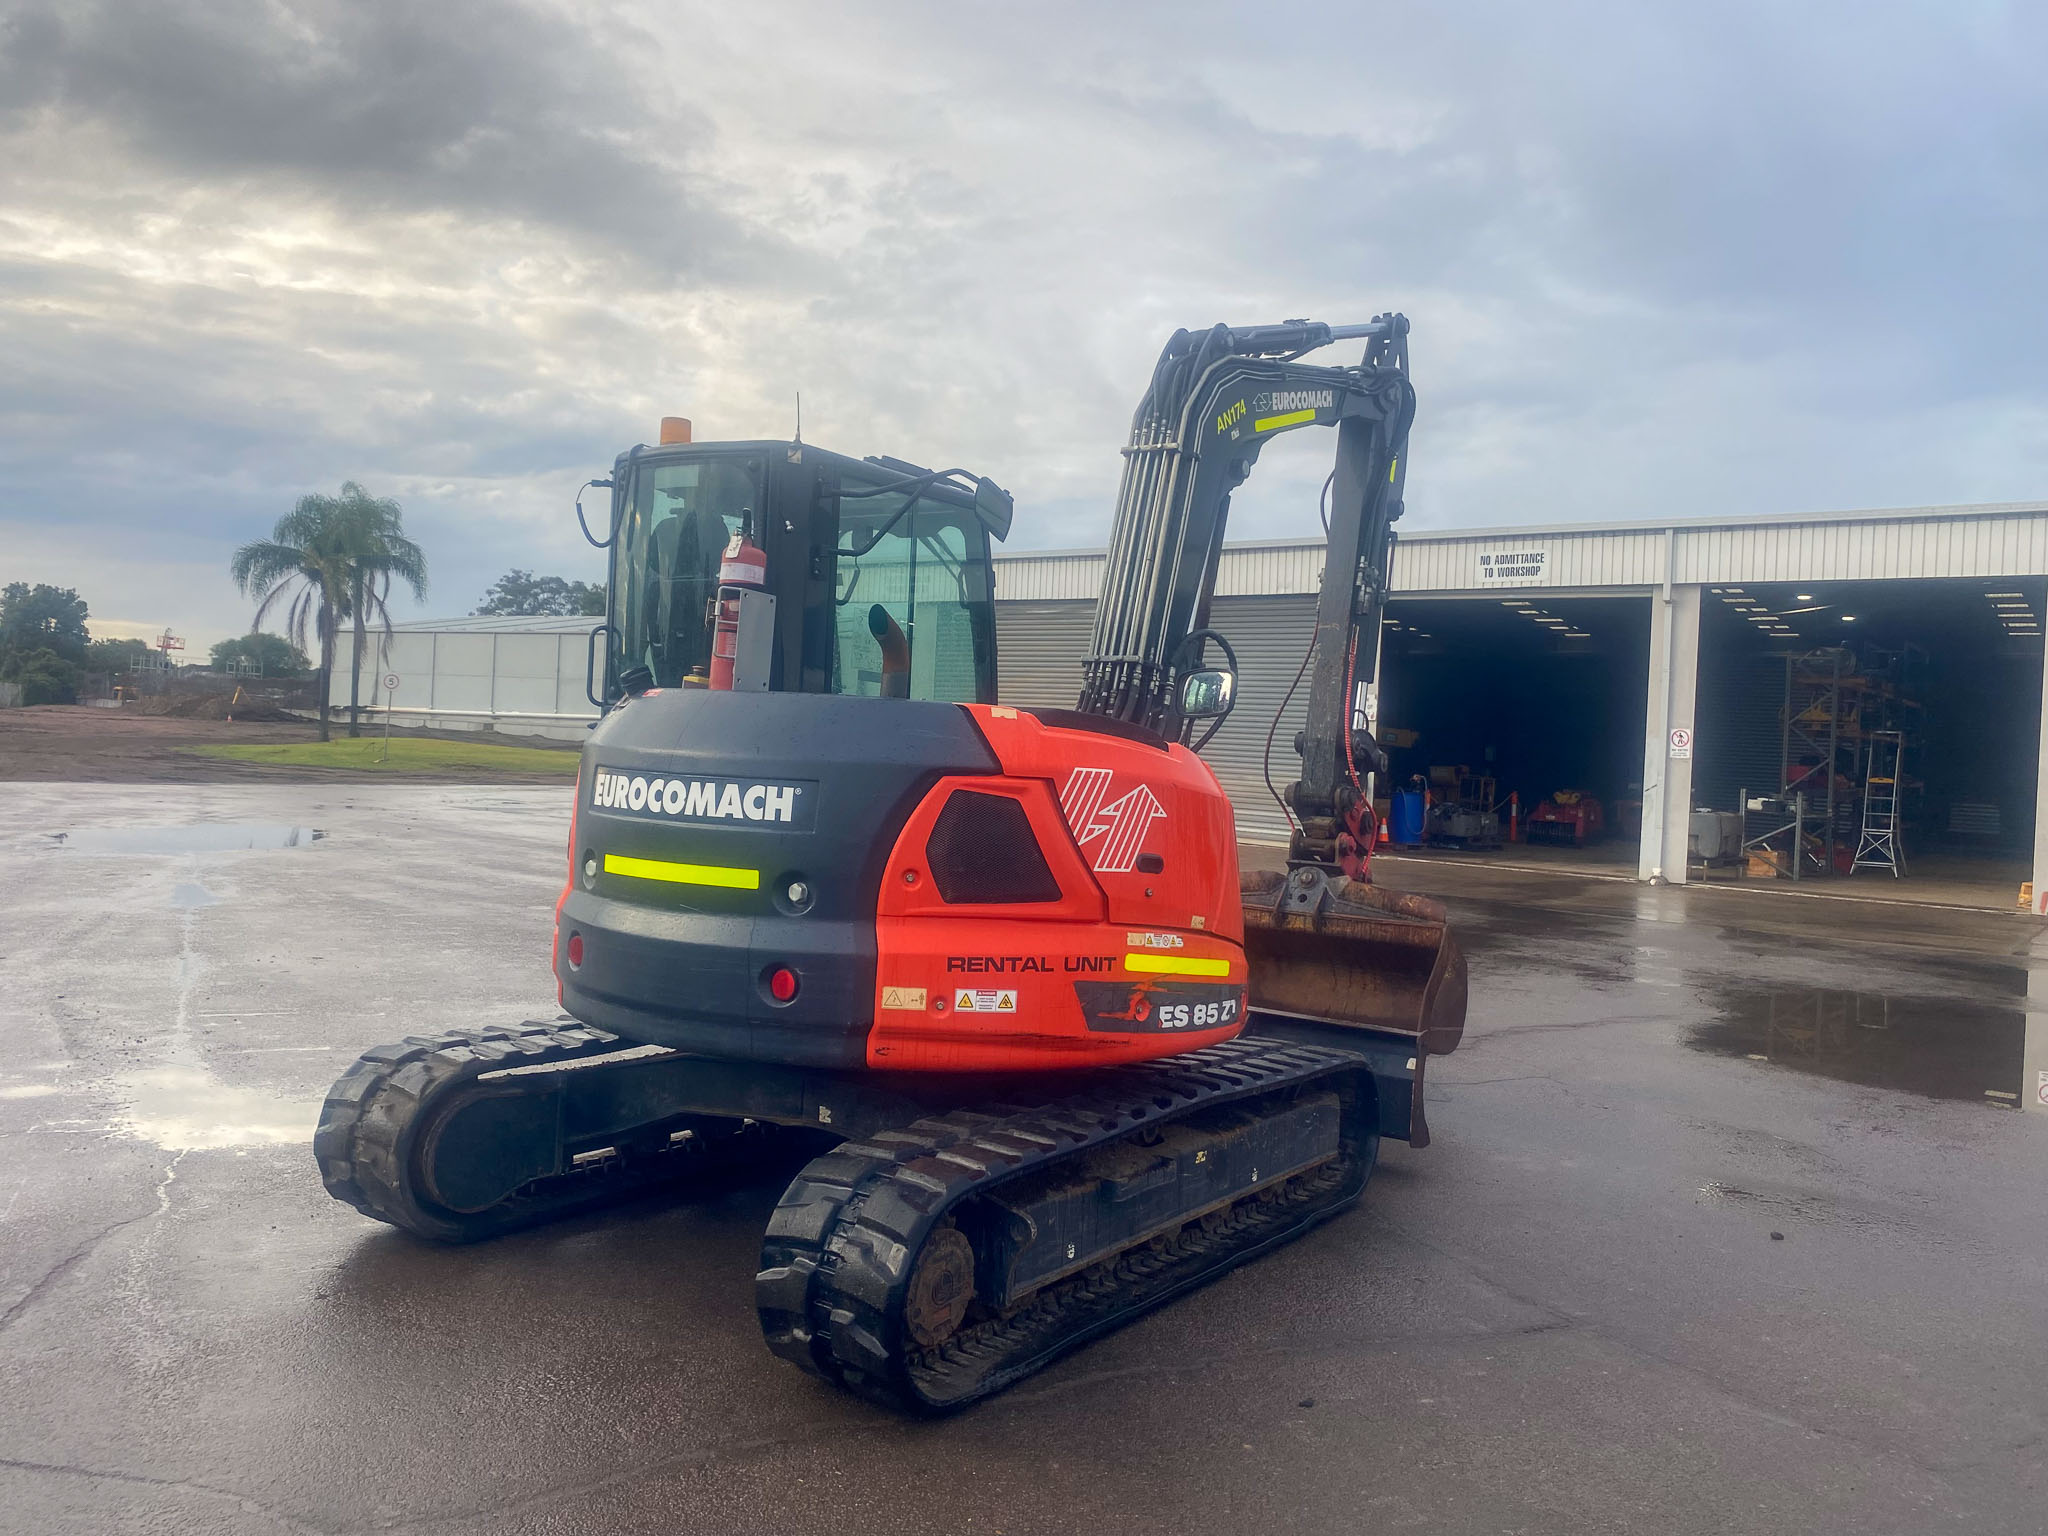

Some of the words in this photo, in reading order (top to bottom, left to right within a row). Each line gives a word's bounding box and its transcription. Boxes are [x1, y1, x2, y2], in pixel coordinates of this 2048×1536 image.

[1272, 390, 1333, 410] EUROCOMACH
[1217, 398, 1246, 435] AN174
[1480, 556, 1491, 565] NO
[1495, 553, 1545, 565] ADMITTANCE
[1484, 567, 1493, 578] TO
[1497, 566, 1541, 578] WORKSHOP
[947, 956, 1054, 972] RENTAL
[1064, 956, 1117, 972] UNIT
[1159, 1005, 1189, 1028] ES
[1193, 1003, 1219, 1025] 85
